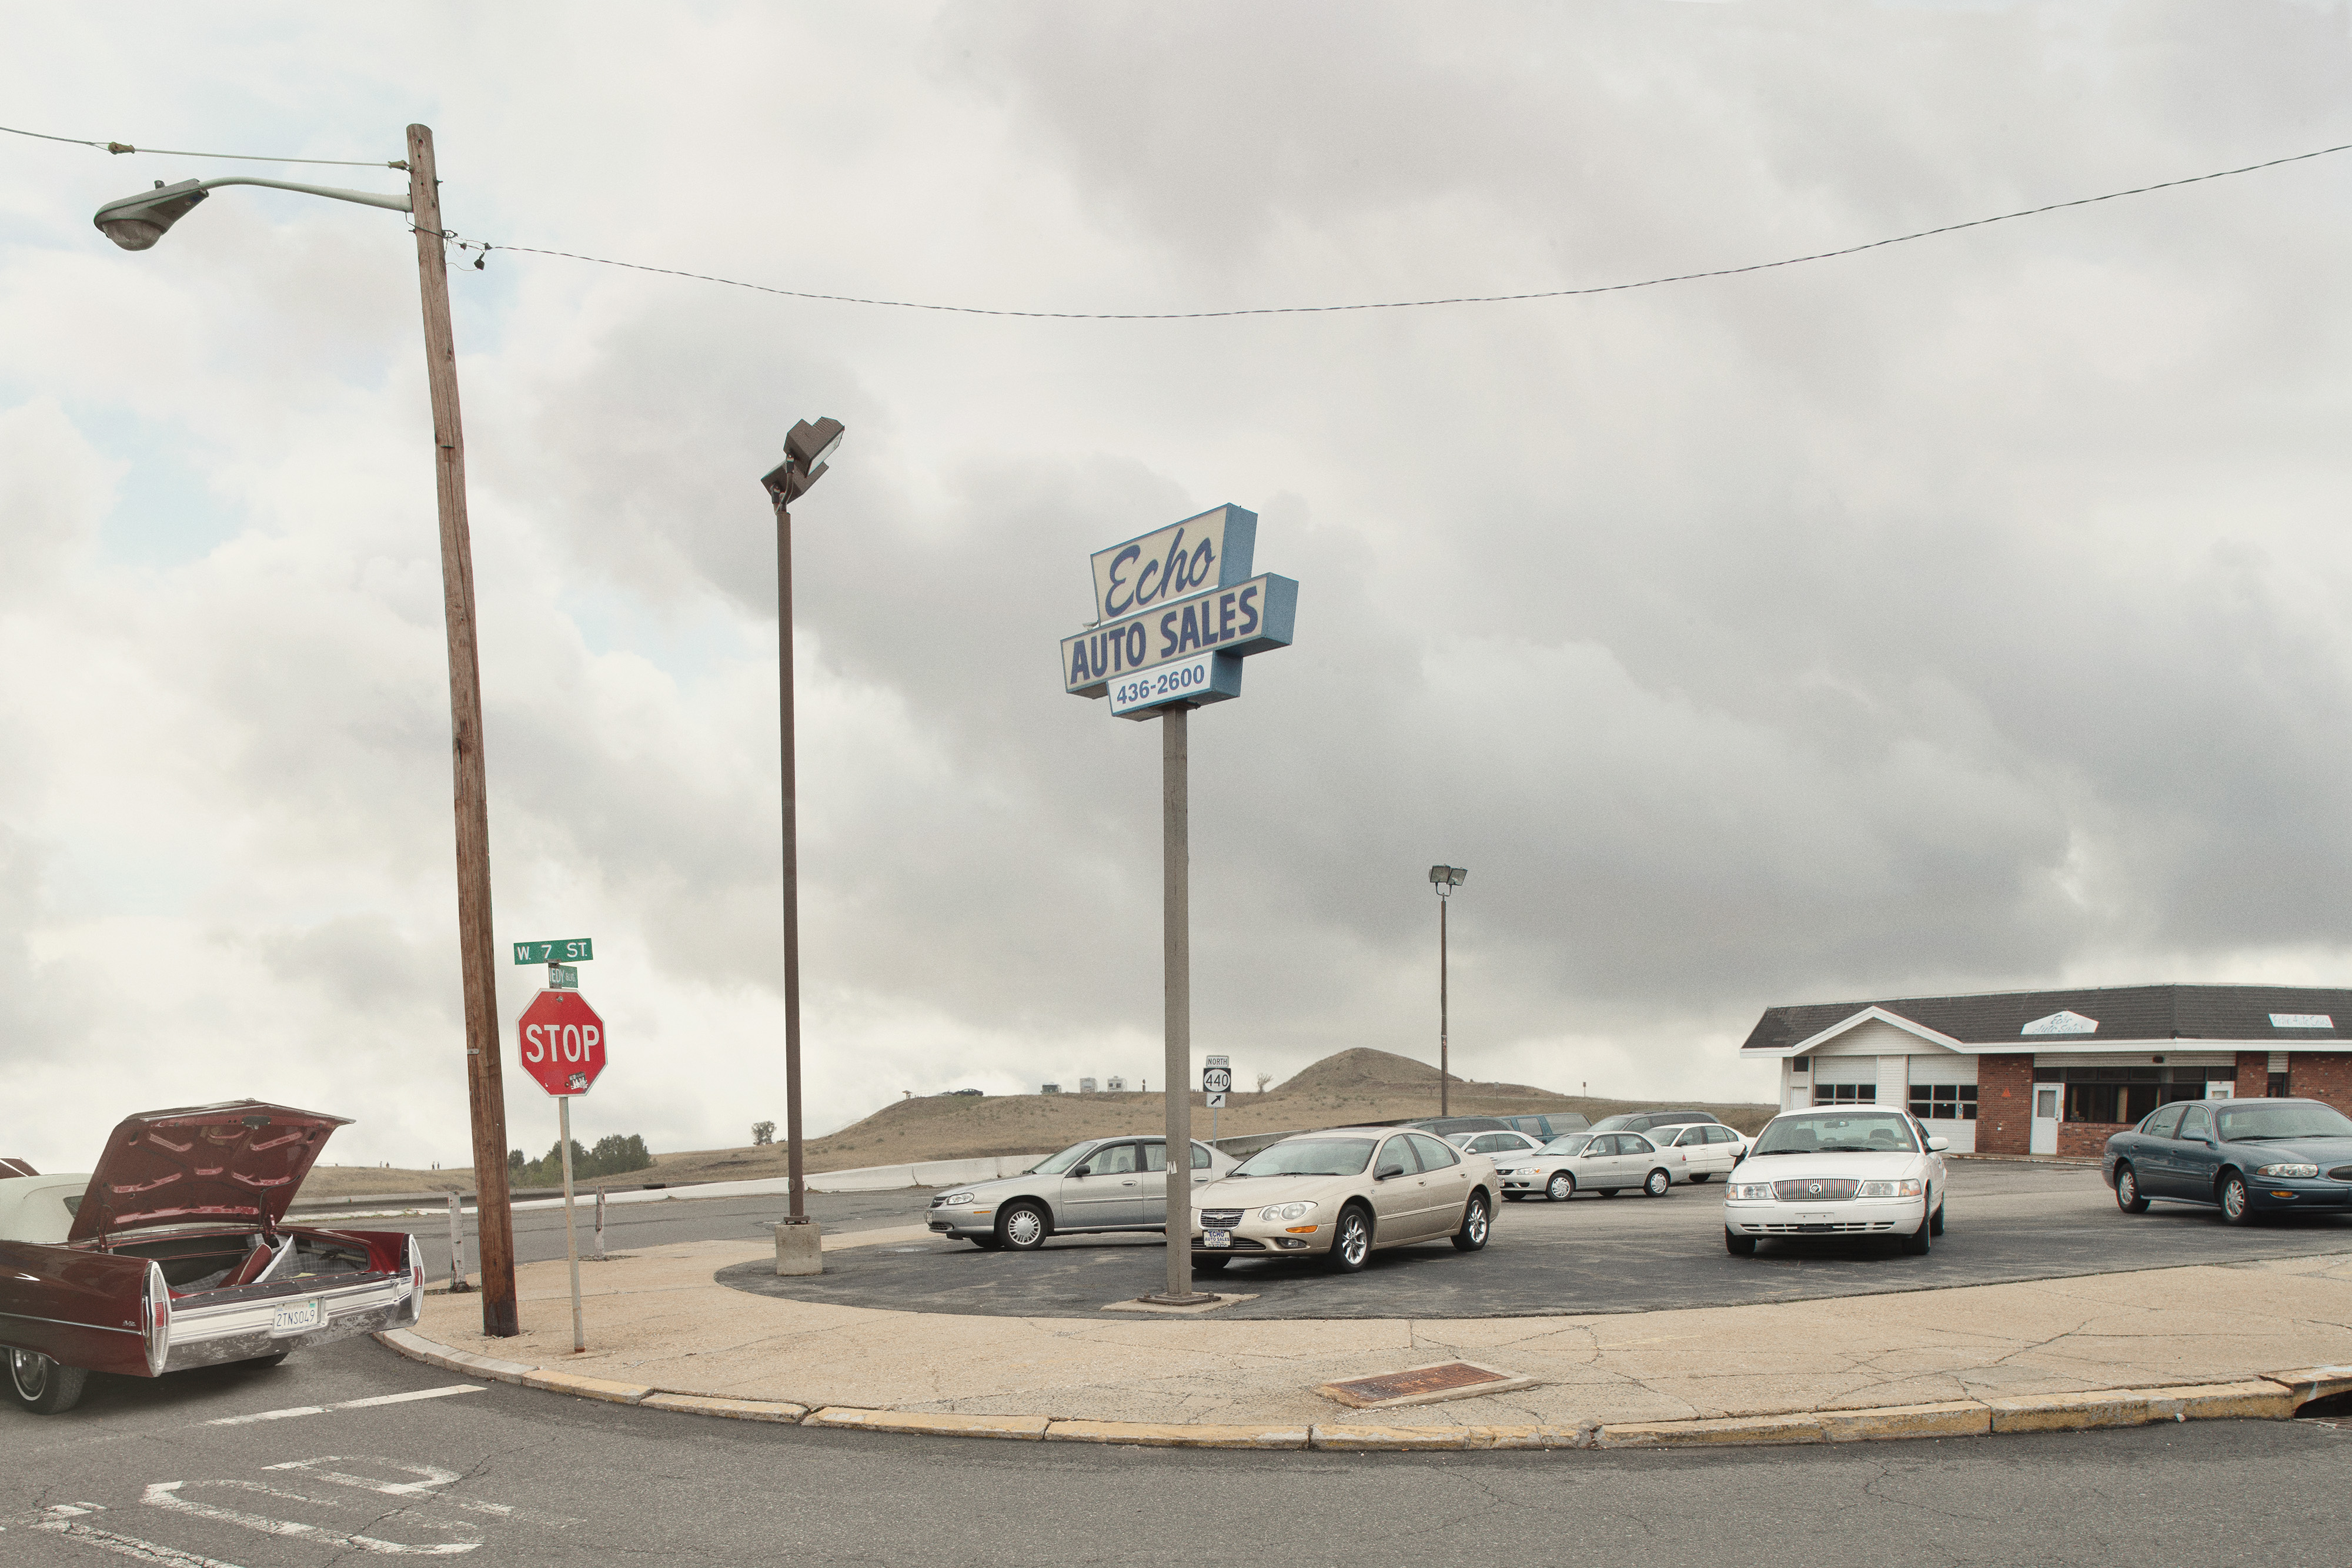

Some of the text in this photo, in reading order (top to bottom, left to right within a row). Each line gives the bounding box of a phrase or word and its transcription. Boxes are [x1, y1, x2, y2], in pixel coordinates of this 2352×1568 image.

[1105, 527, 1216, 617] Echo
[1070, 586, 1258, 685] AUTO SALES
[1117, 664, 1205, 704] 436-2600
[517, 942, 587, 960] W. 7 ST.
[526, 1024, 600, 1063] STOP
[1205, 1074, 1228, 1087] 440
[276, 1309, 315, 1327] 2TNS049
